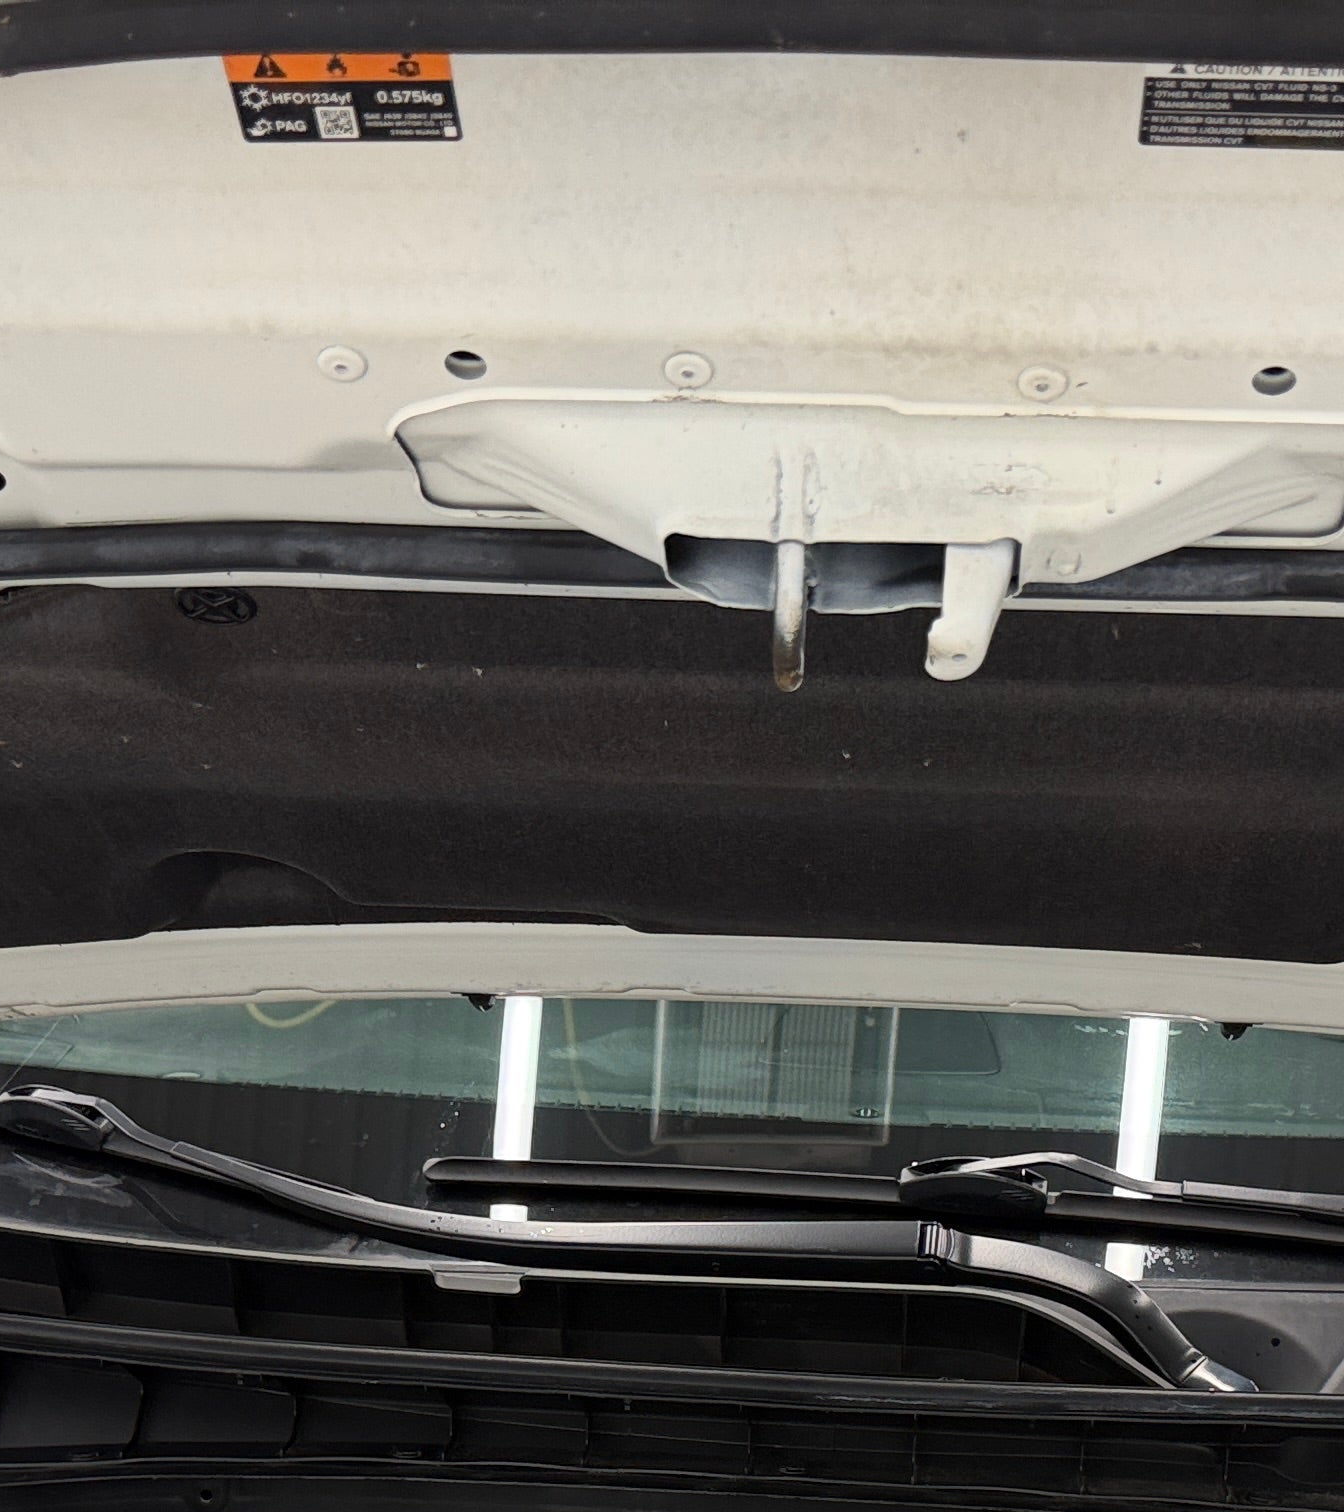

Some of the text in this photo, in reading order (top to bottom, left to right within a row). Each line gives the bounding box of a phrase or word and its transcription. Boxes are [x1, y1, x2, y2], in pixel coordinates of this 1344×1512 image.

[1194, 64, 1263, 75] CAUTION
[1155, 81, 1176, 89] USE
[1180, 81, 1207, 89] ONLY
[1211, 82, 1251, 90] NISSAN
[1254, 83, 1275, 91] CVT
[1278, 83, 1308, 91] FLUID
[272, 91, 352, 106] HFO1234yf
[376, 90, 443, 106] 0.575kg
[1154, 90, 1189, 99] OTHER
[1192, 91, 1229, 100] FLUIDS
[1232, 92, 1256, 101] WILL
[1260, 93, 1304, 102] DAMAGE
[1309, 94, 1329, 102] THE
[276, 120, 306, 133] PAG
[1205, 116, 1227, 125] QUE
[1228, 117, 1244, 125] DU
[1285, 118, 1304, 127] CVT
[1306, 119, 1344, 127] NISSAN
[1149, 135, 1244, 145] TRANSMISSION CVT
